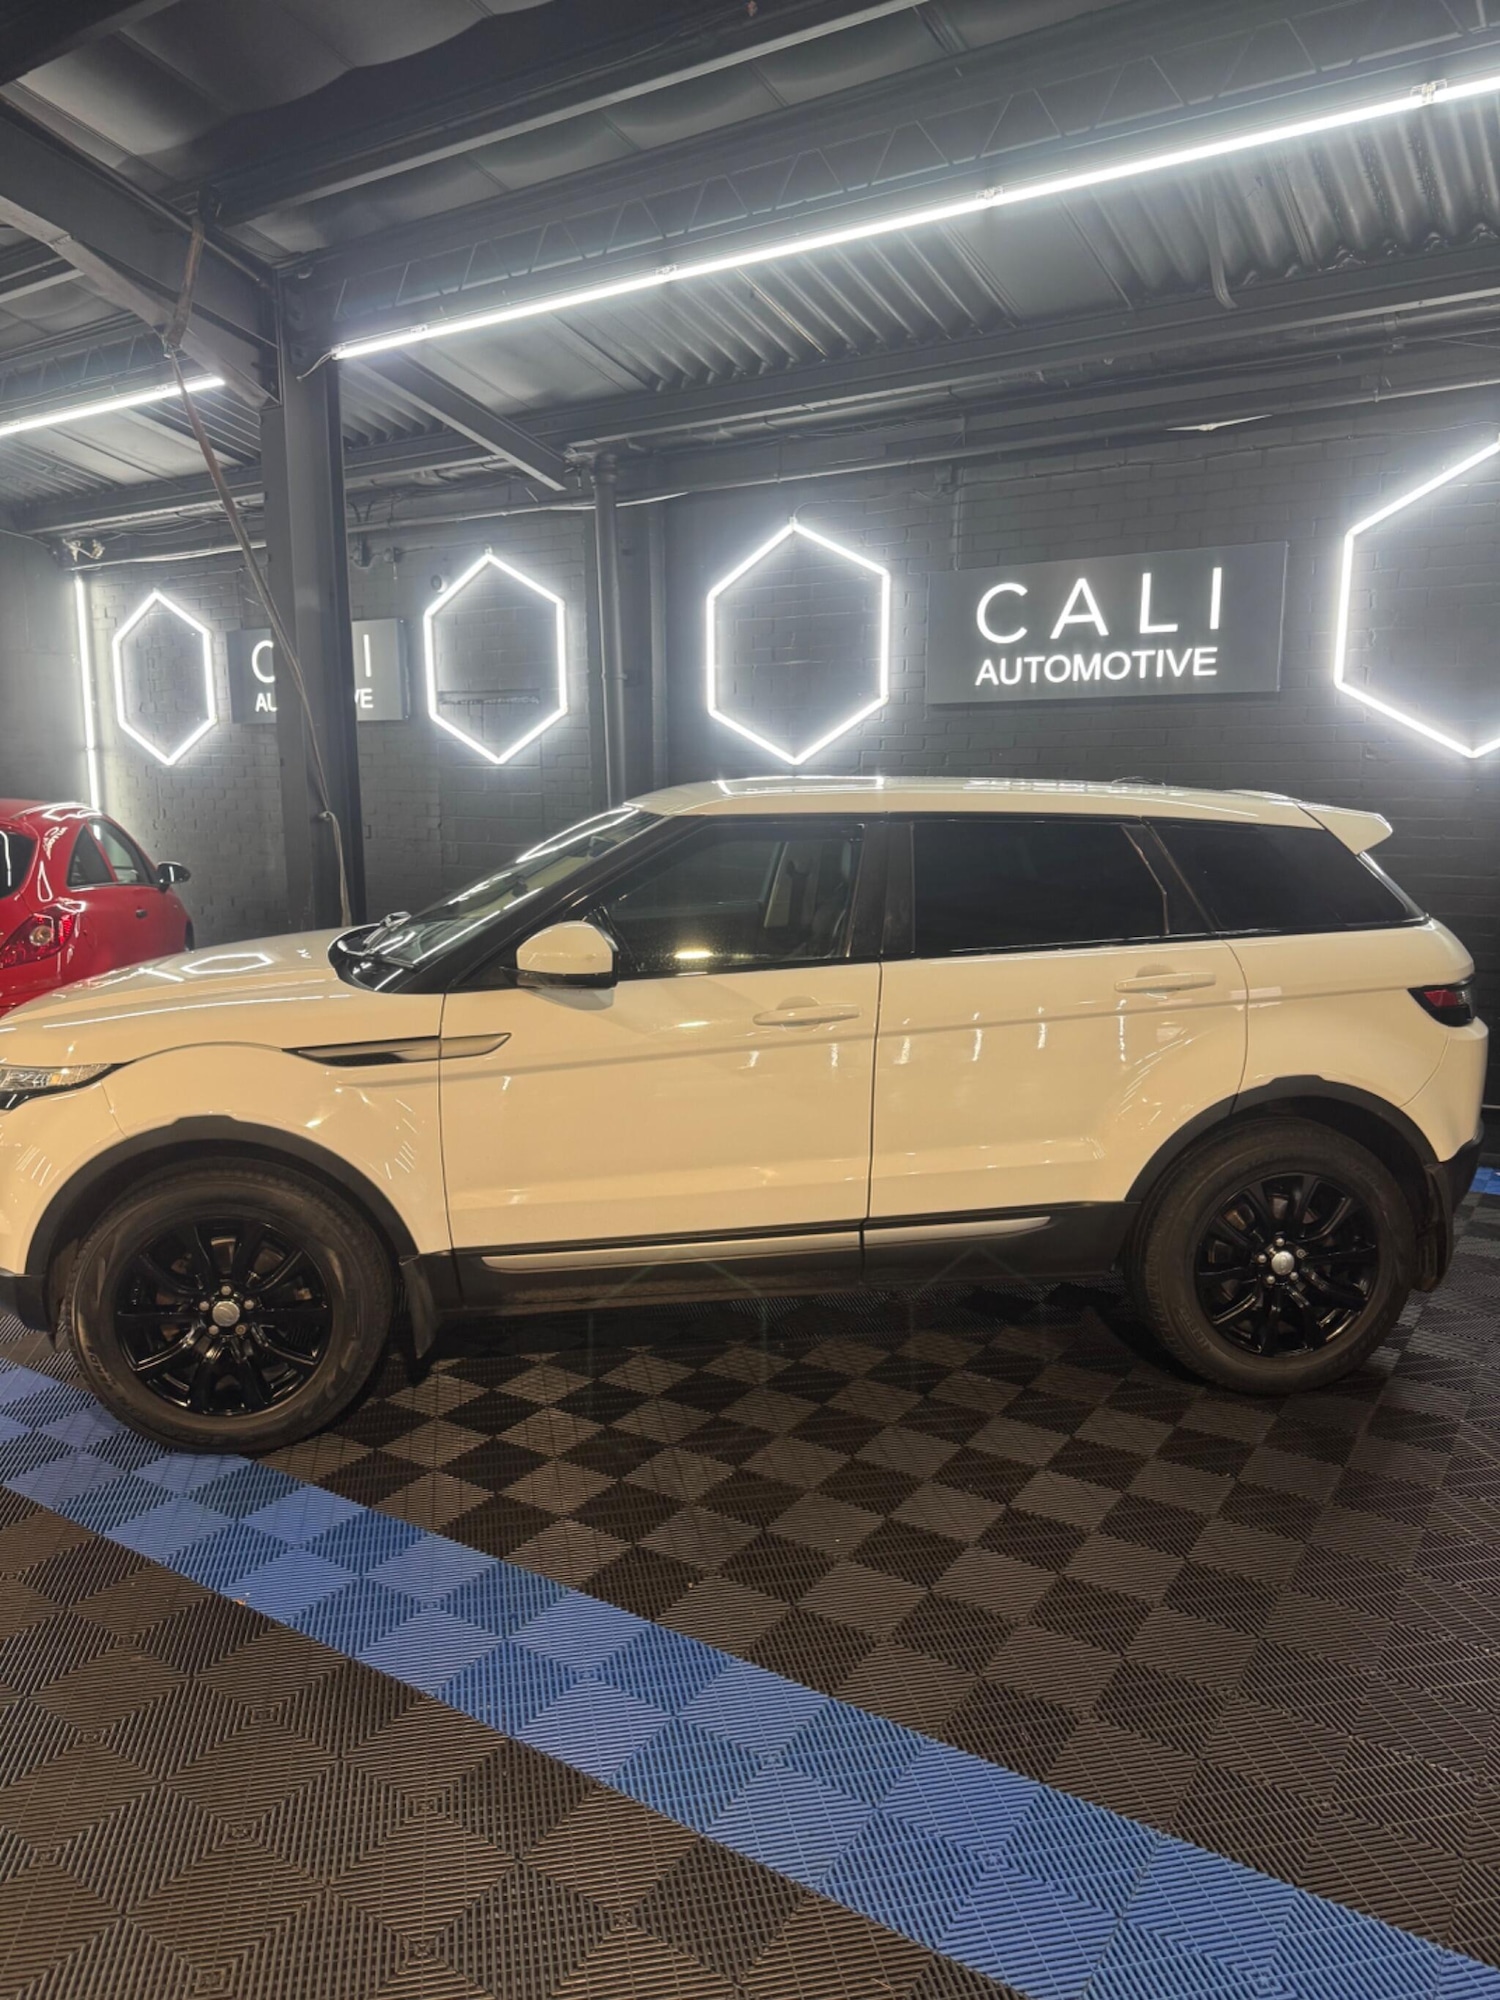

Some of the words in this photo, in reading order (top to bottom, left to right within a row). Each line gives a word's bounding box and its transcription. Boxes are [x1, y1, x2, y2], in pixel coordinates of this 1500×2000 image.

[976, 567, 1222, 644] CALI
[251, 634, 372, 684] CI
[975, 647, 1218, 686] AUTOMOTIVE
